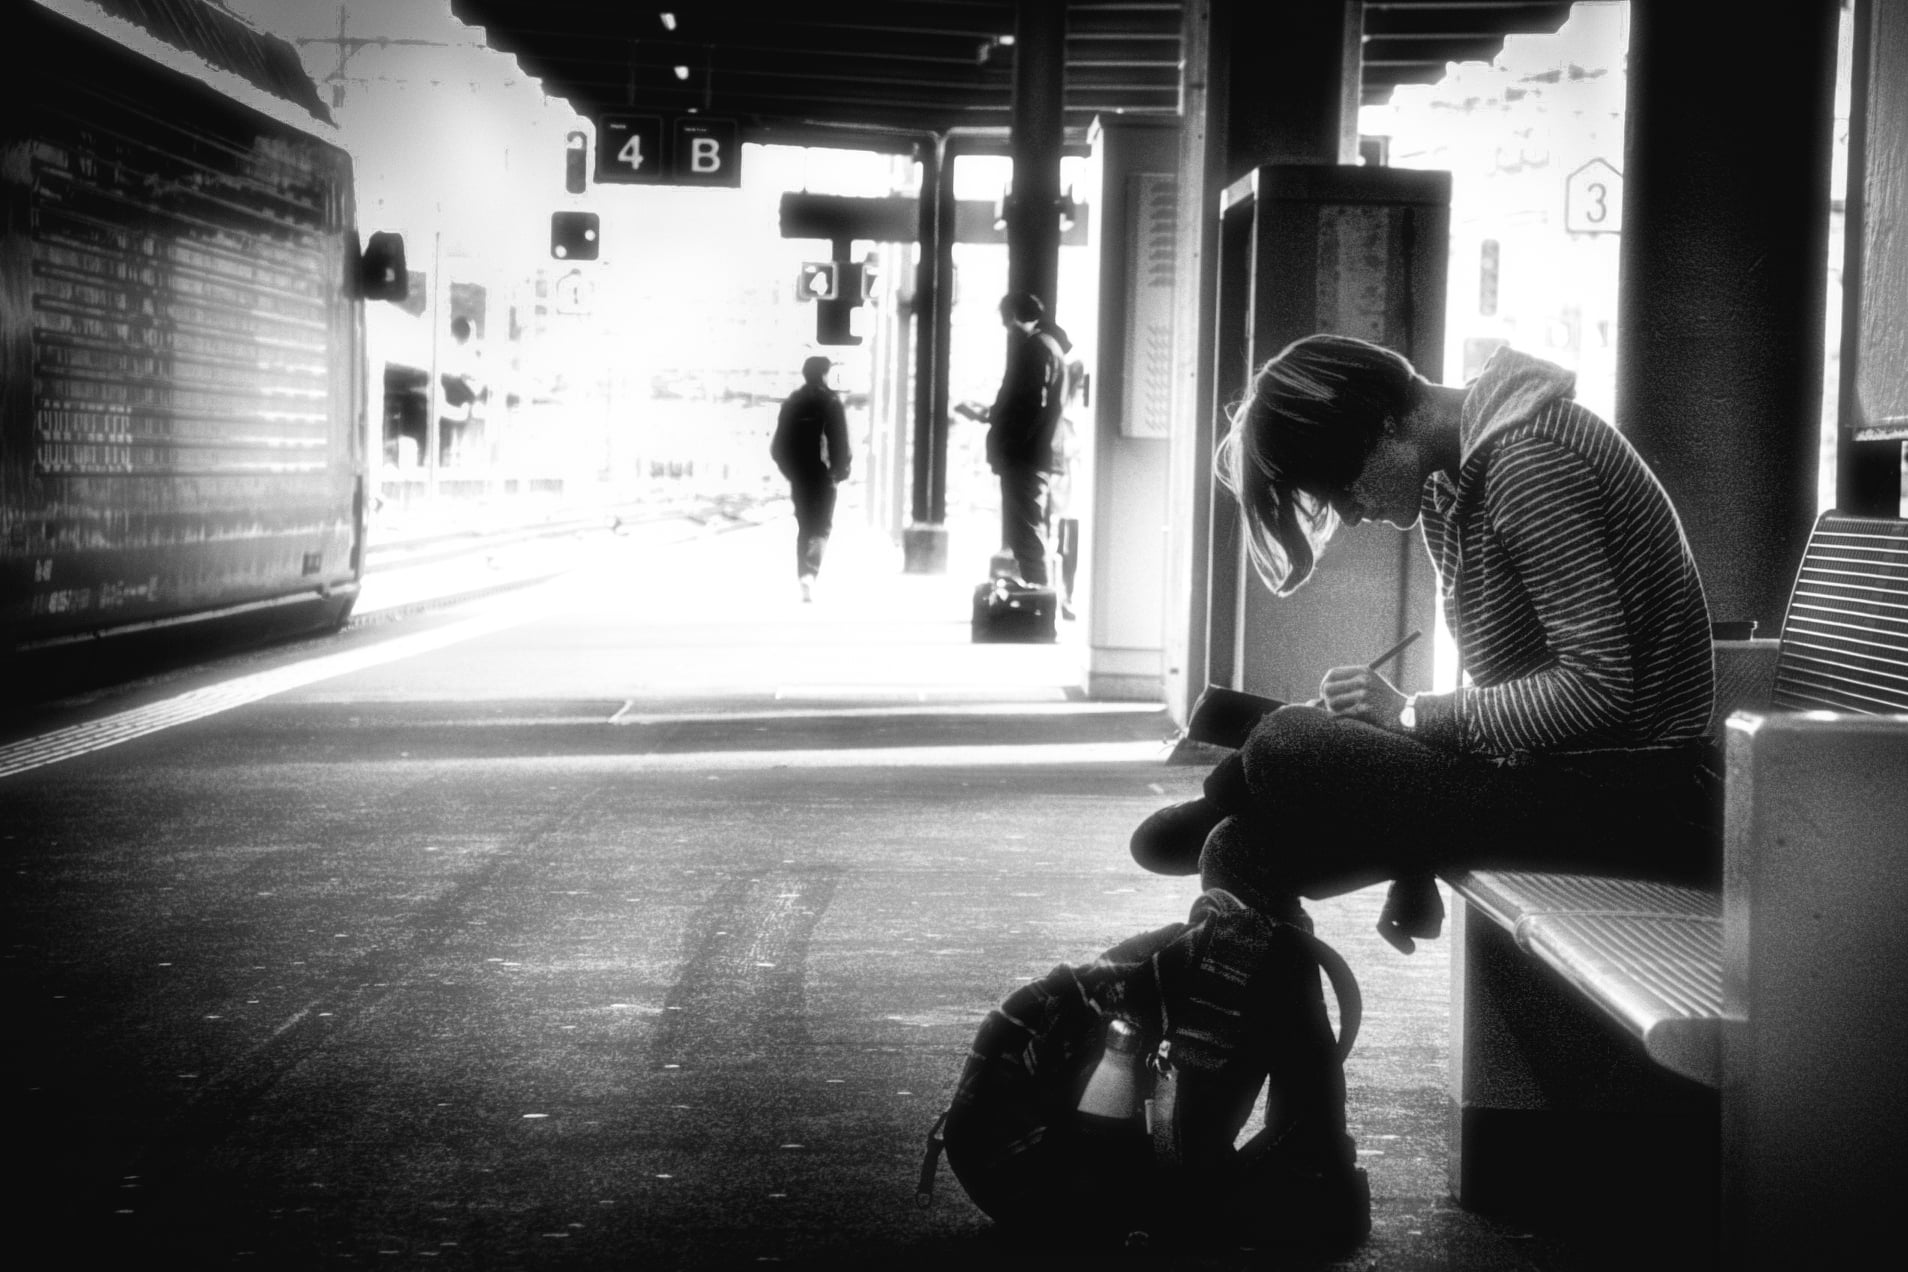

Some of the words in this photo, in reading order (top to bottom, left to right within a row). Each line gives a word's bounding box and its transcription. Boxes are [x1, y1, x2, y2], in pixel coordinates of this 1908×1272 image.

[617, 134, 644, 170] 4
[691, 137, 721, 173] B
[1587, 183, 1606, 222] 3
